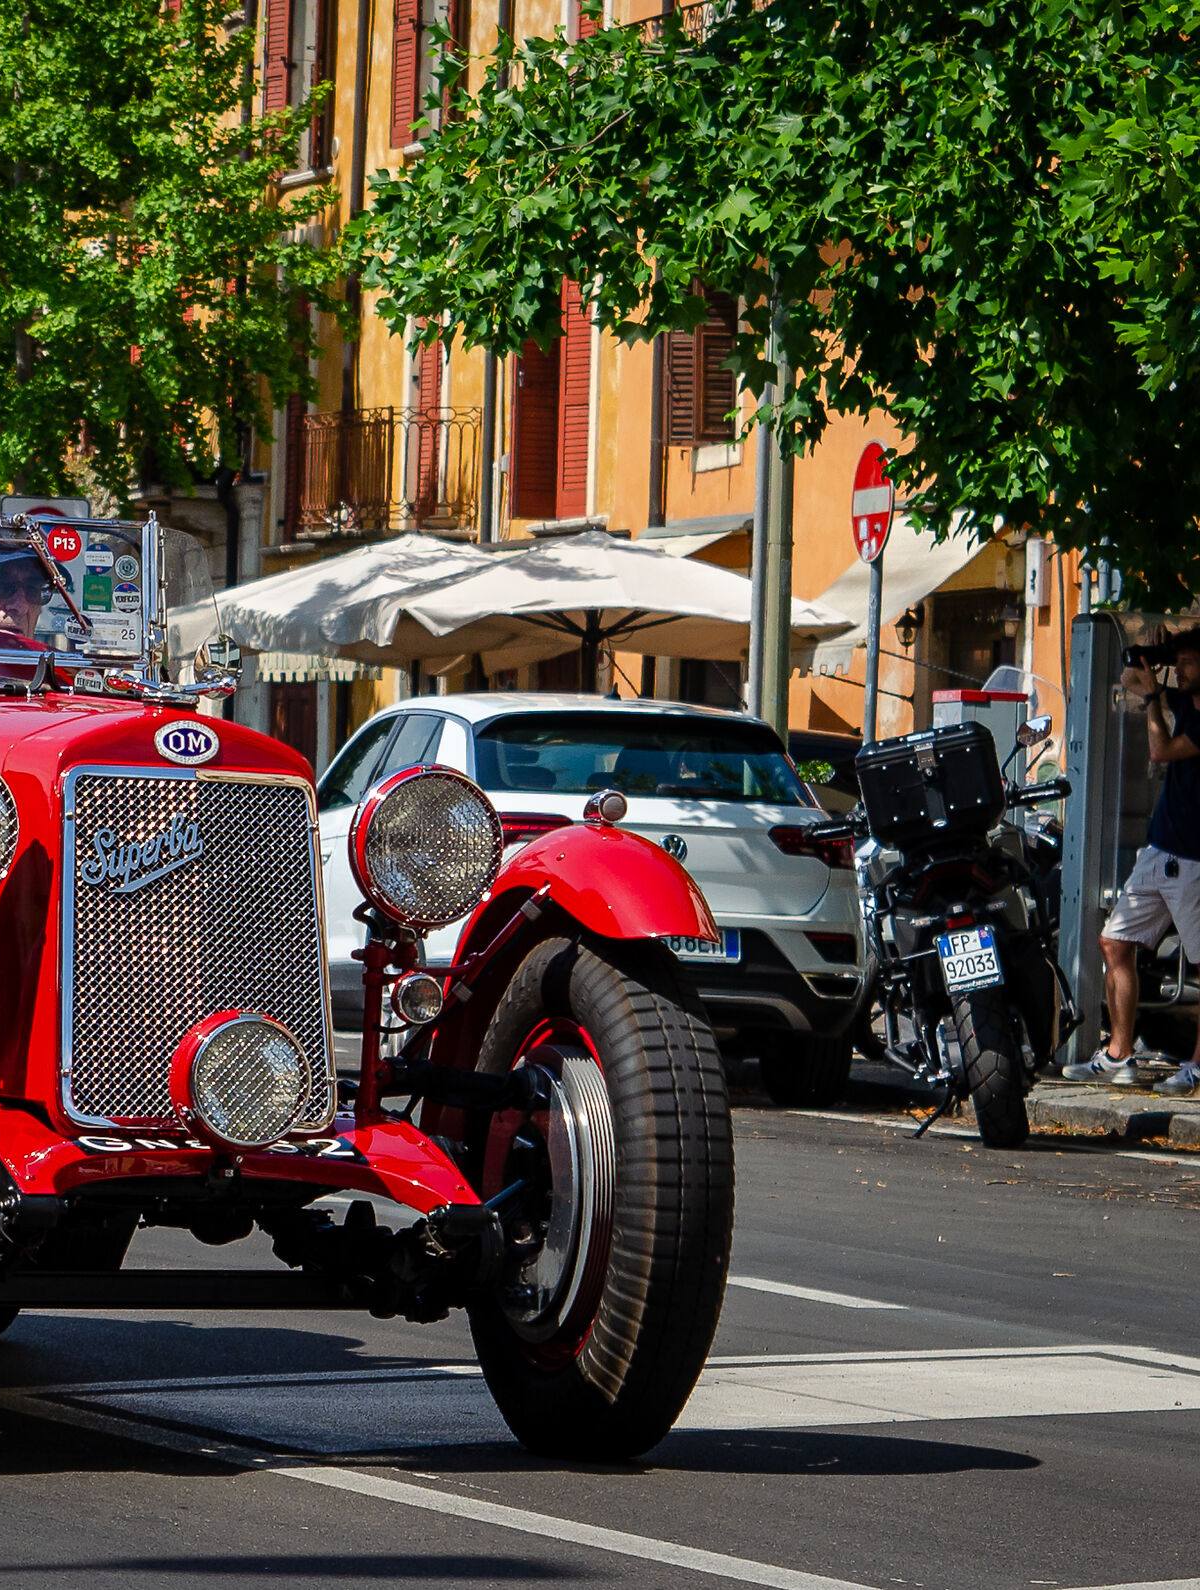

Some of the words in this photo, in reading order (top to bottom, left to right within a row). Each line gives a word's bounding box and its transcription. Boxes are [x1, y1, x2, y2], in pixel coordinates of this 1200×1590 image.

[53, 536, 77, 550] P13
[121, 629, 136, 640] 25
[168, 730, 207, 753] OM
[80, 811, 203, 885] Superba
[951, 935, 970, 955] FP
[946, 952, 995, 979] 92033
